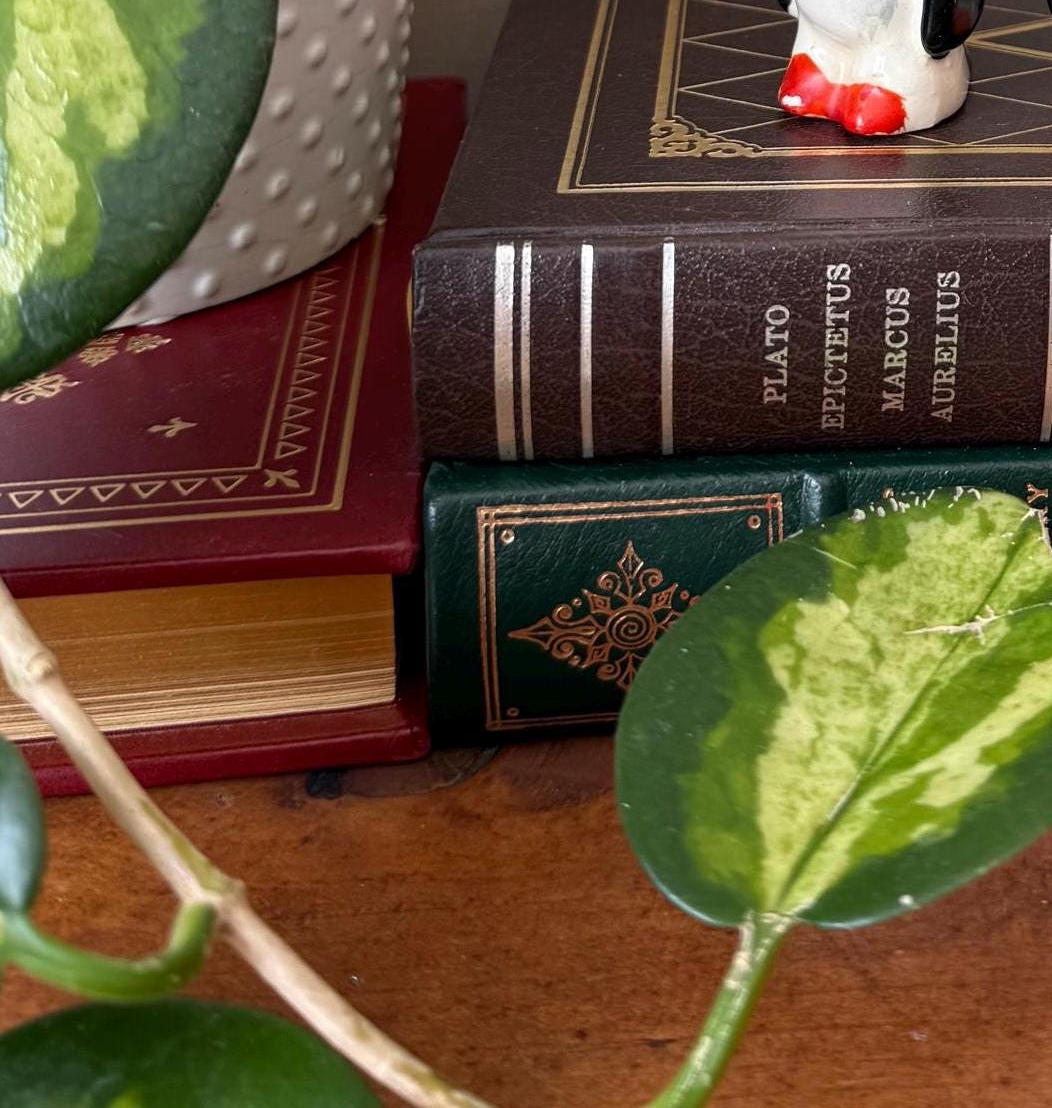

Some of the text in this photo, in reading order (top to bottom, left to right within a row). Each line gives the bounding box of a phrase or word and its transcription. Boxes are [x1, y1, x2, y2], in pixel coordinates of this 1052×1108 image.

[763, 304, 790, 404] PLATO
[822, 262, 852, 430] EPICTETUS
[881, 286, 911, 412] MARCUS
[930, 270, 961, 423] AURELIUS
